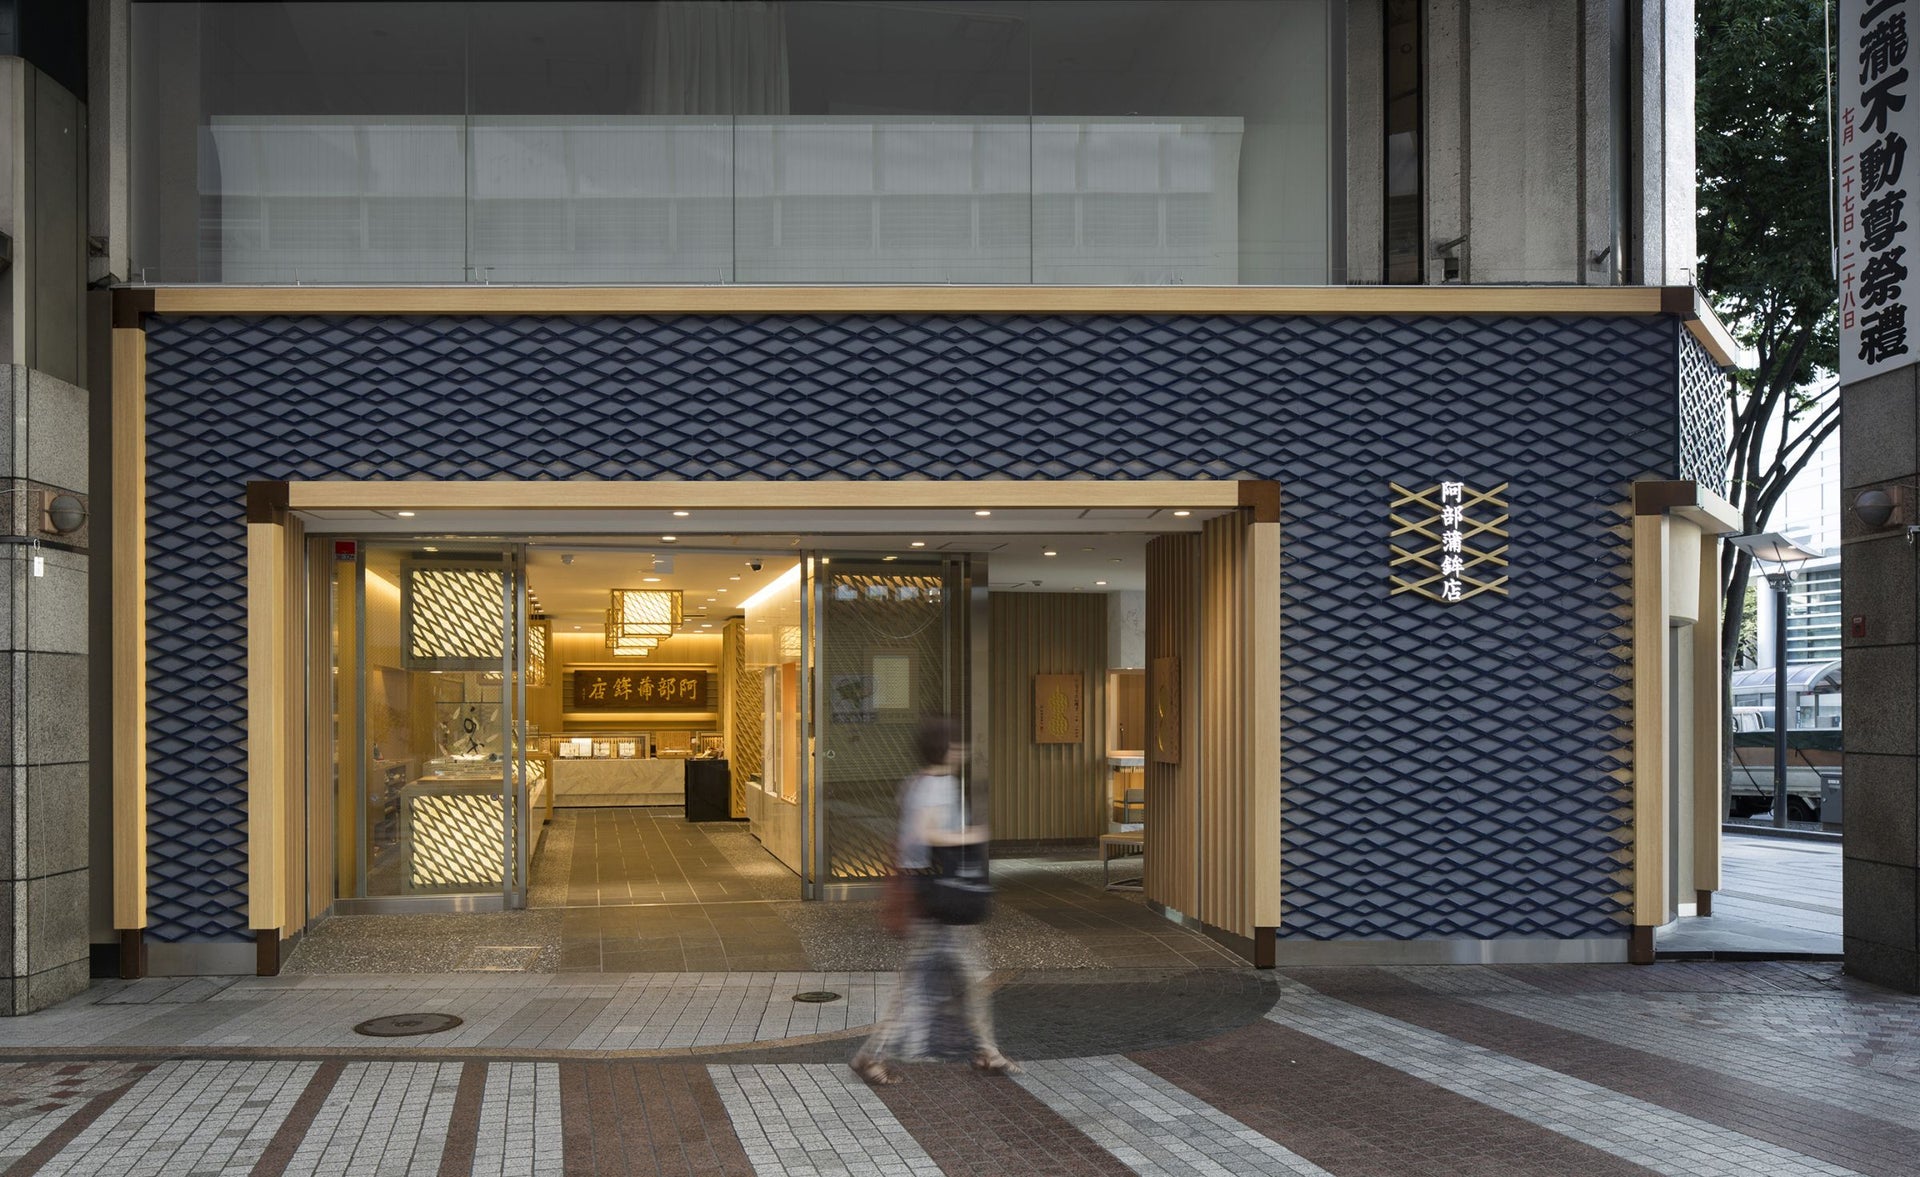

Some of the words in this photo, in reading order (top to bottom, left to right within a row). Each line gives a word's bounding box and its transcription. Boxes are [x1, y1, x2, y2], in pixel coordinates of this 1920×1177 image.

[1441, 481, 1464, 601] 阿部蒲鉾店
